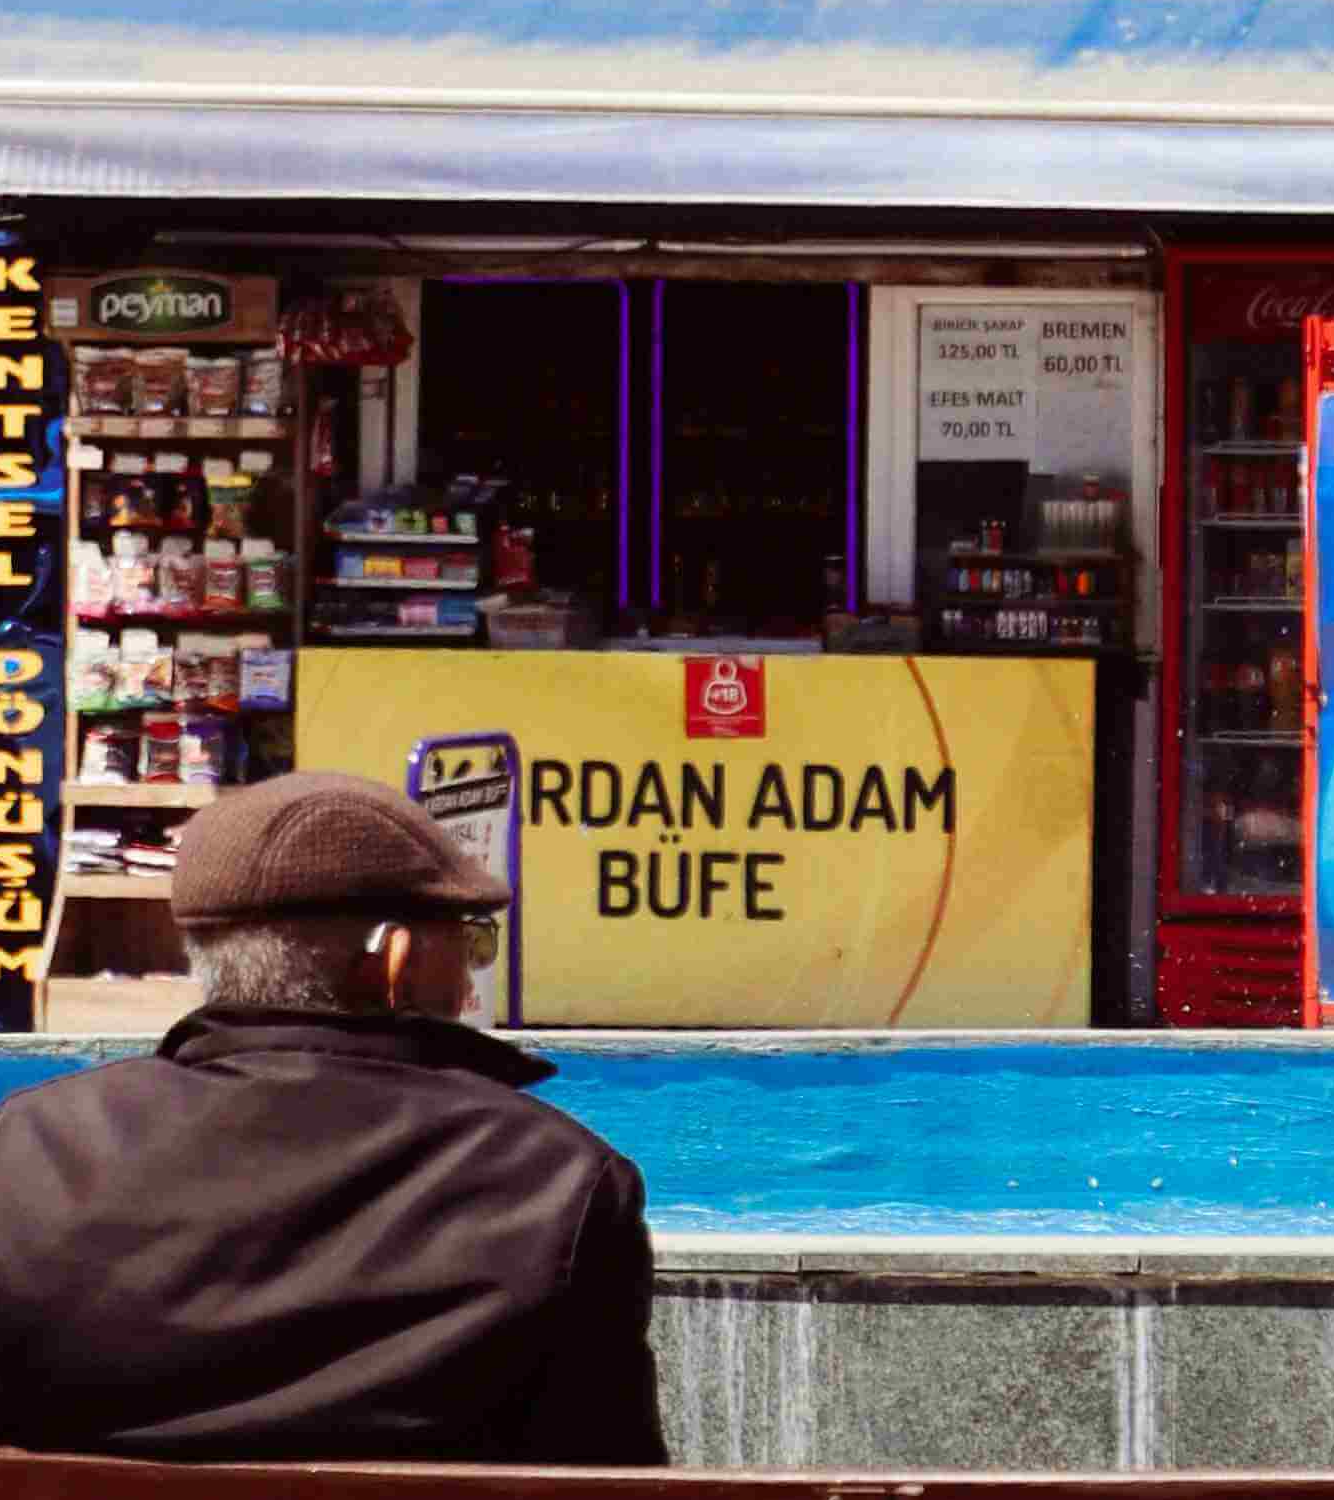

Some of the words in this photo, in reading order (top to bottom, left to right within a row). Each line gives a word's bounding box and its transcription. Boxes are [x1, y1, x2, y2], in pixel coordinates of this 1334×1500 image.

[98, 290, 223, 325] peyman
[1042, 321, 1127, 340] BREMEN
[938, 343, 997, 361] 125,00
[1002, 344, 1020, 361] TL
[1043, 355, 1098, 376] 60,00
[1102, 355, 1124, 374] TL
[929, 390, 972, 408] EFES
[976, 389, 1026, 408] MALT
[941, 420, 991, 439] 70,00
[994, 420, 1015, 438] TL
[521, 759, 726, 830] RDAN
[747, 760, 957, 834] ADAM
[597, 832, 786, 921] BÜFE
